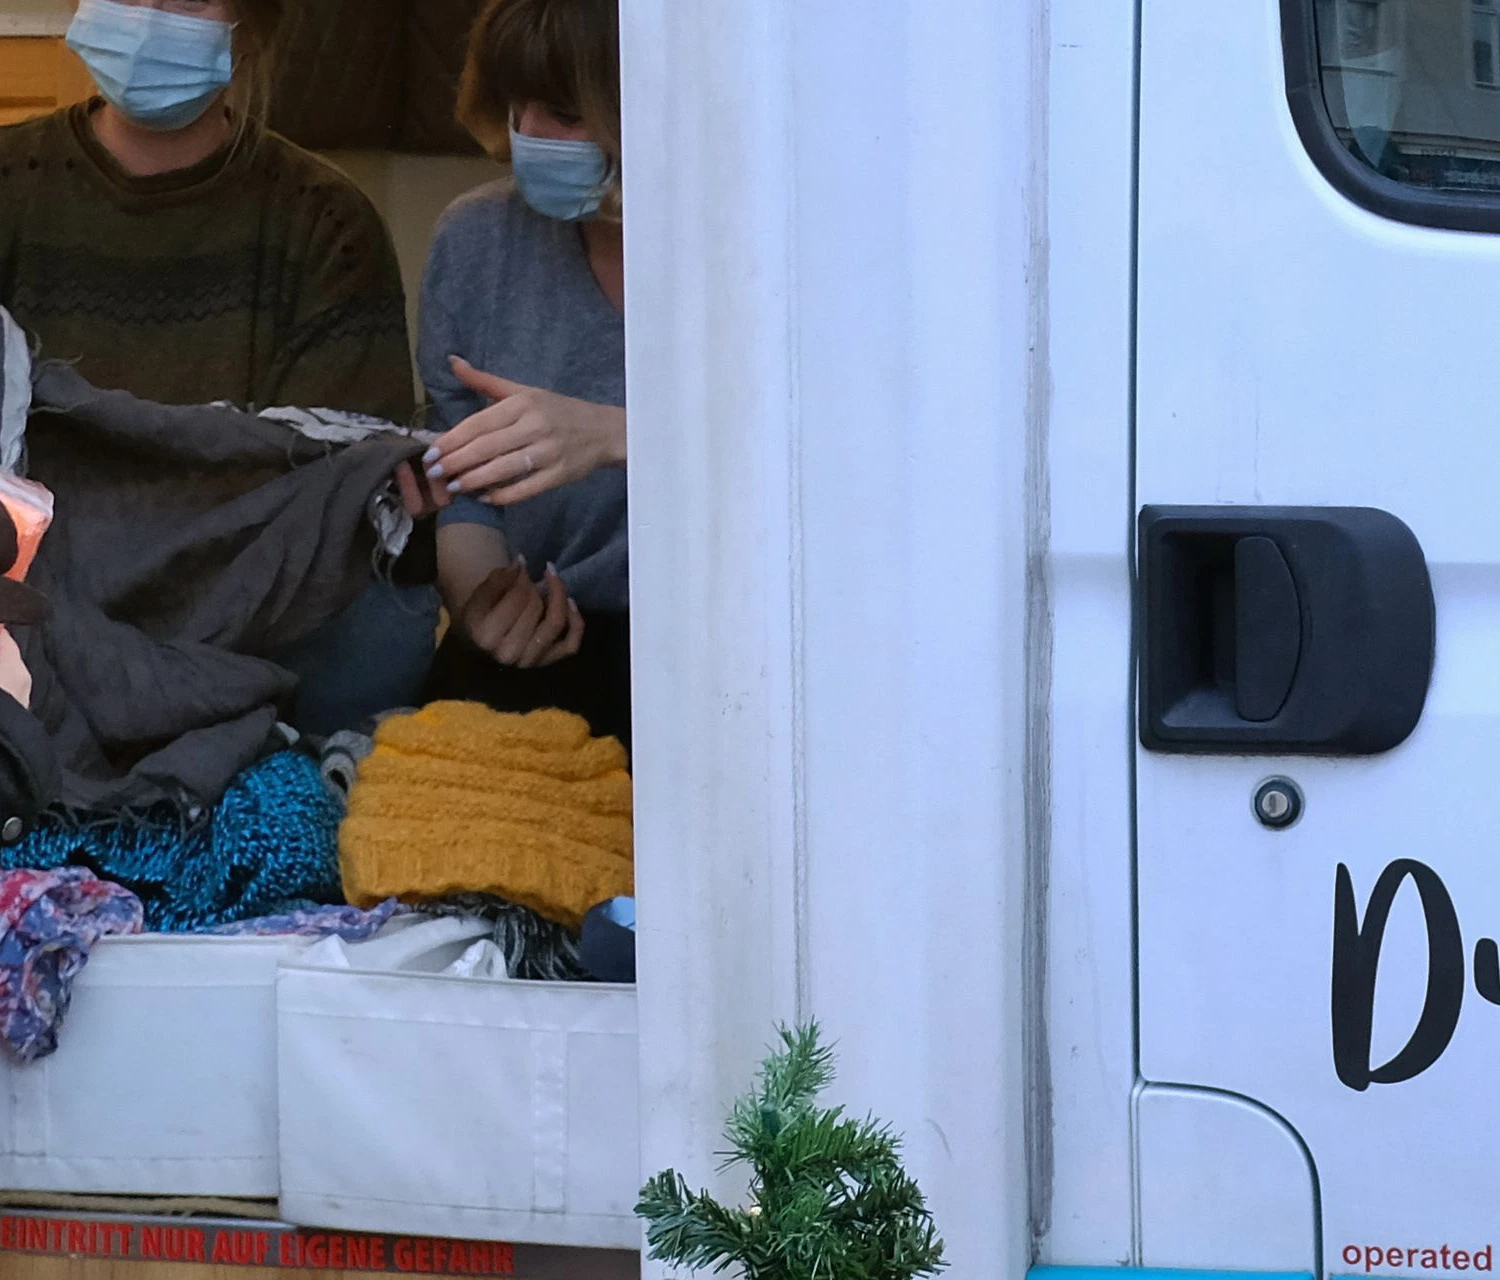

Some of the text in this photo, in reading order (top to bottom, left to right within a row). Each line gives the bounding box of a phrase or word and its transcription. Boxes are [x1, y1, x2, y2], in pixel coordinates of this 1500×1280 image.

[0, 1216, 515, 1275] EINTRITT NUR AUF EIGENE GEFAHR
[1342, 1244, 1493, 1272] operated
